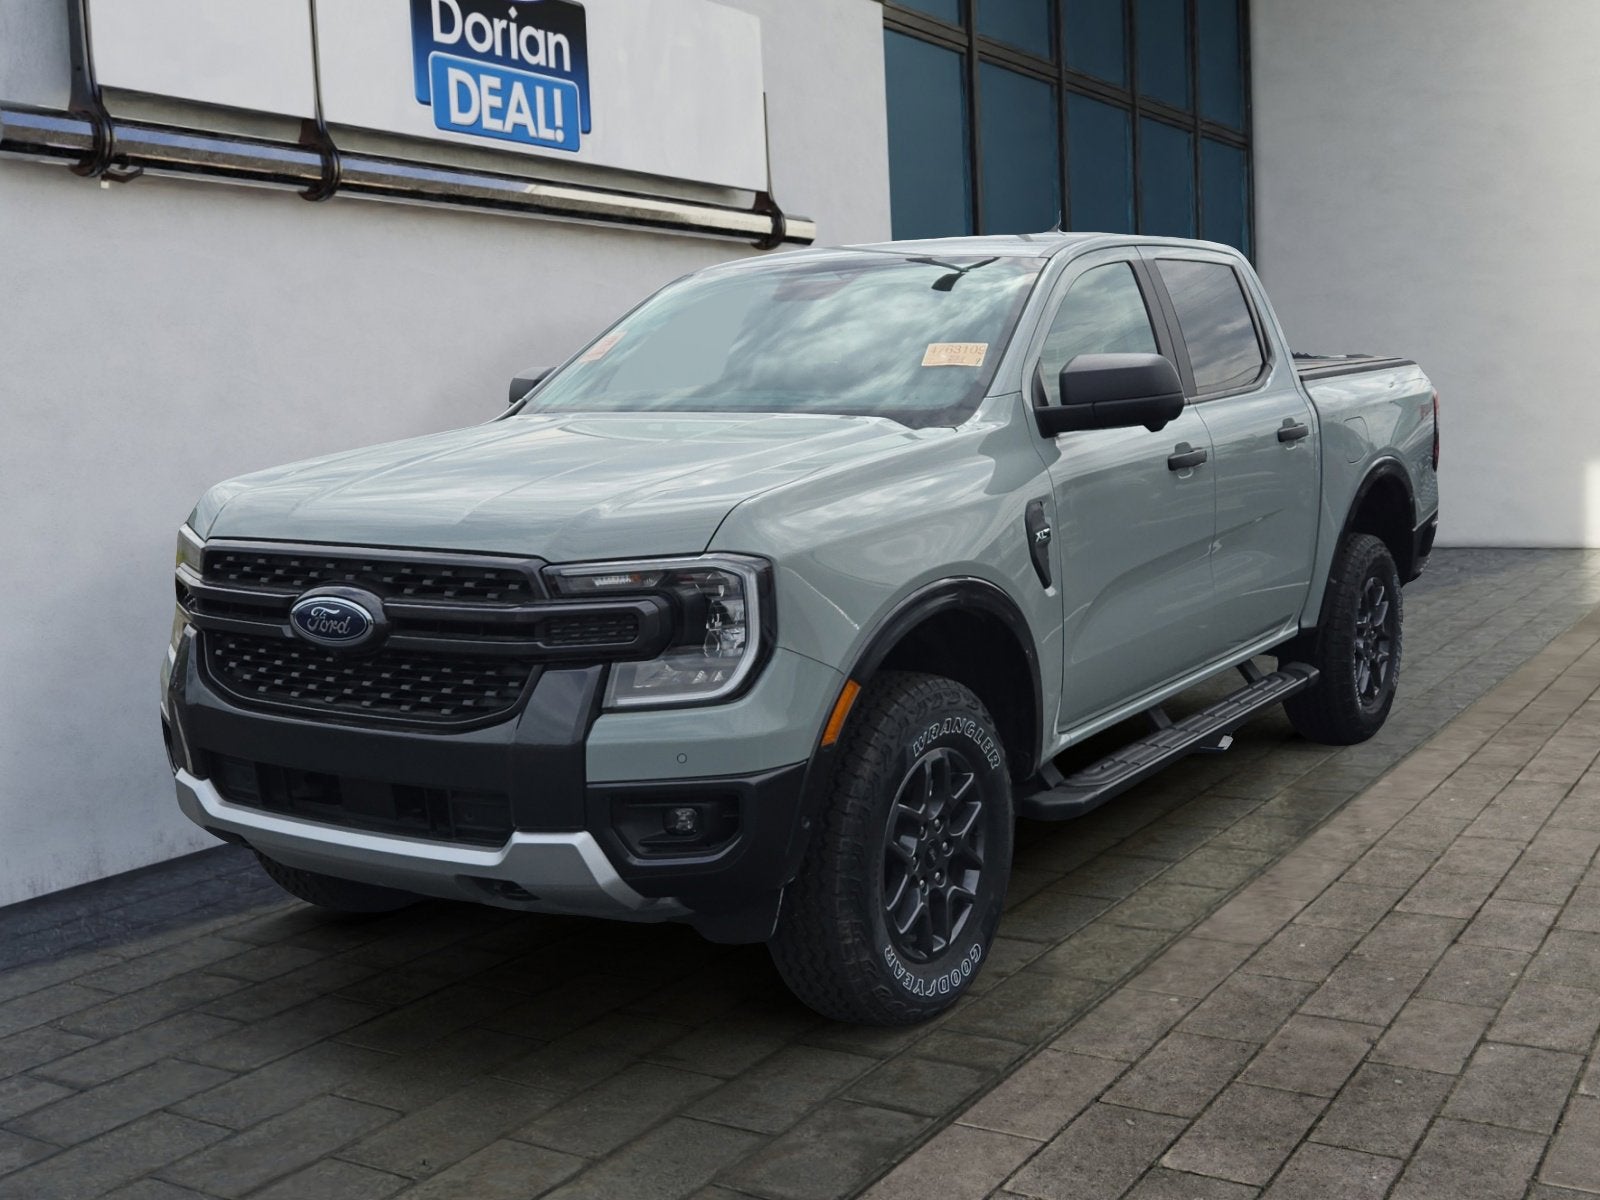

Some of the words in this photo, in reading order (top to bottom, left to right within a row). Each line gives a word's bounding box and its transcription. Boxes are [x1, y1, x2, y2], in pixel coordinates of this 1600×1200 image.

[431, 0, 571, 72] Dorian
[447, 67, 565, 143] DEAL!
[306, 606, 351, 634] Ford
[912, 717, 1000, 770] WRANGLER
